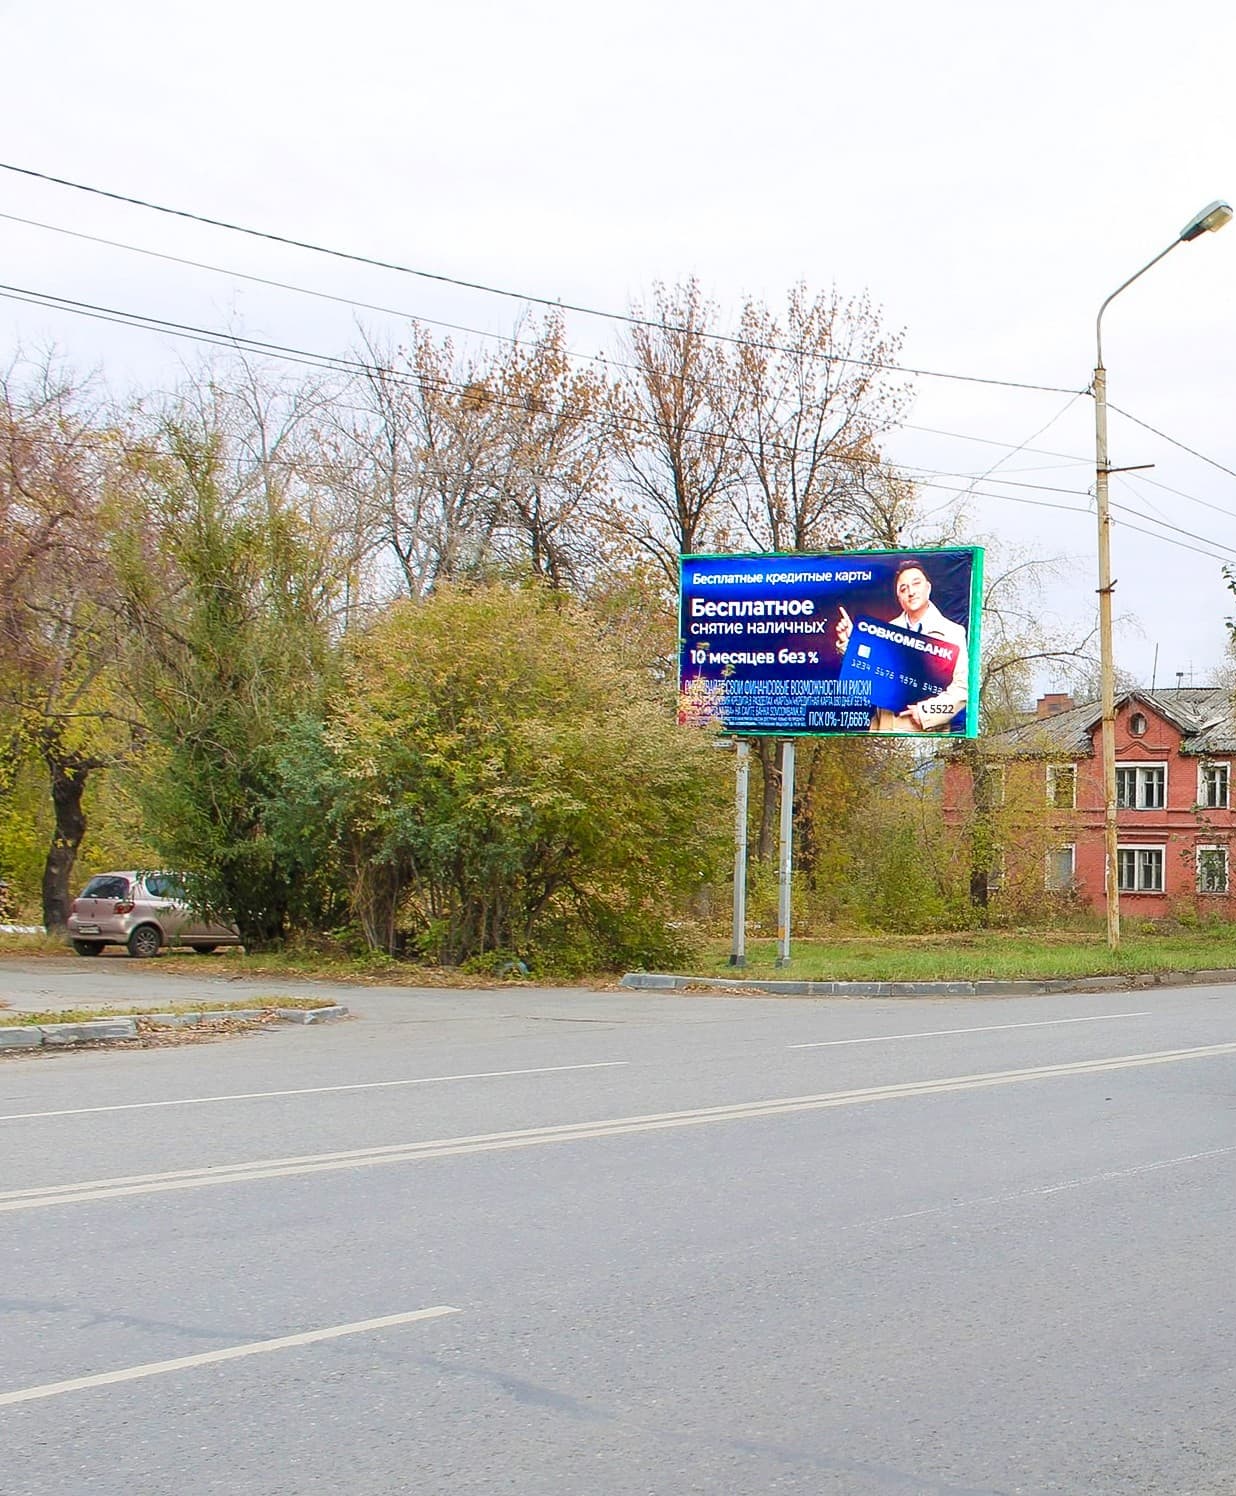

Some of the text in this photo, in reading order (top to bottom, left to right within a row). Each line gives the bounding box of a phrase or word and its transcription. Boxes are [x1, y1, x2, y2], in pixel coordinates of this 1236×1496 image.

[692, 571, 872, 586] Бесплатные кредитные карты
[691, 598, 815, 617] Бесплатное
[690, 623, 743, 636] снятие
[857, 621, 954, 661] СОВКОМБАНК
[690, 648, 819, 666] 10 месяцев без %
[850, 659, 871, 671] 1234
[745, 679, 790, 695] ФИНАНСОВЫЕ
[790, 679, 842, 695] ВОЗМОЖНОСТИ
[842, 680, 848, 695] И
[848, 679, 872, 695] РИСКИ
[930, 704, 954, 714] 5522
[808, 711, 824, 727] ПСК
